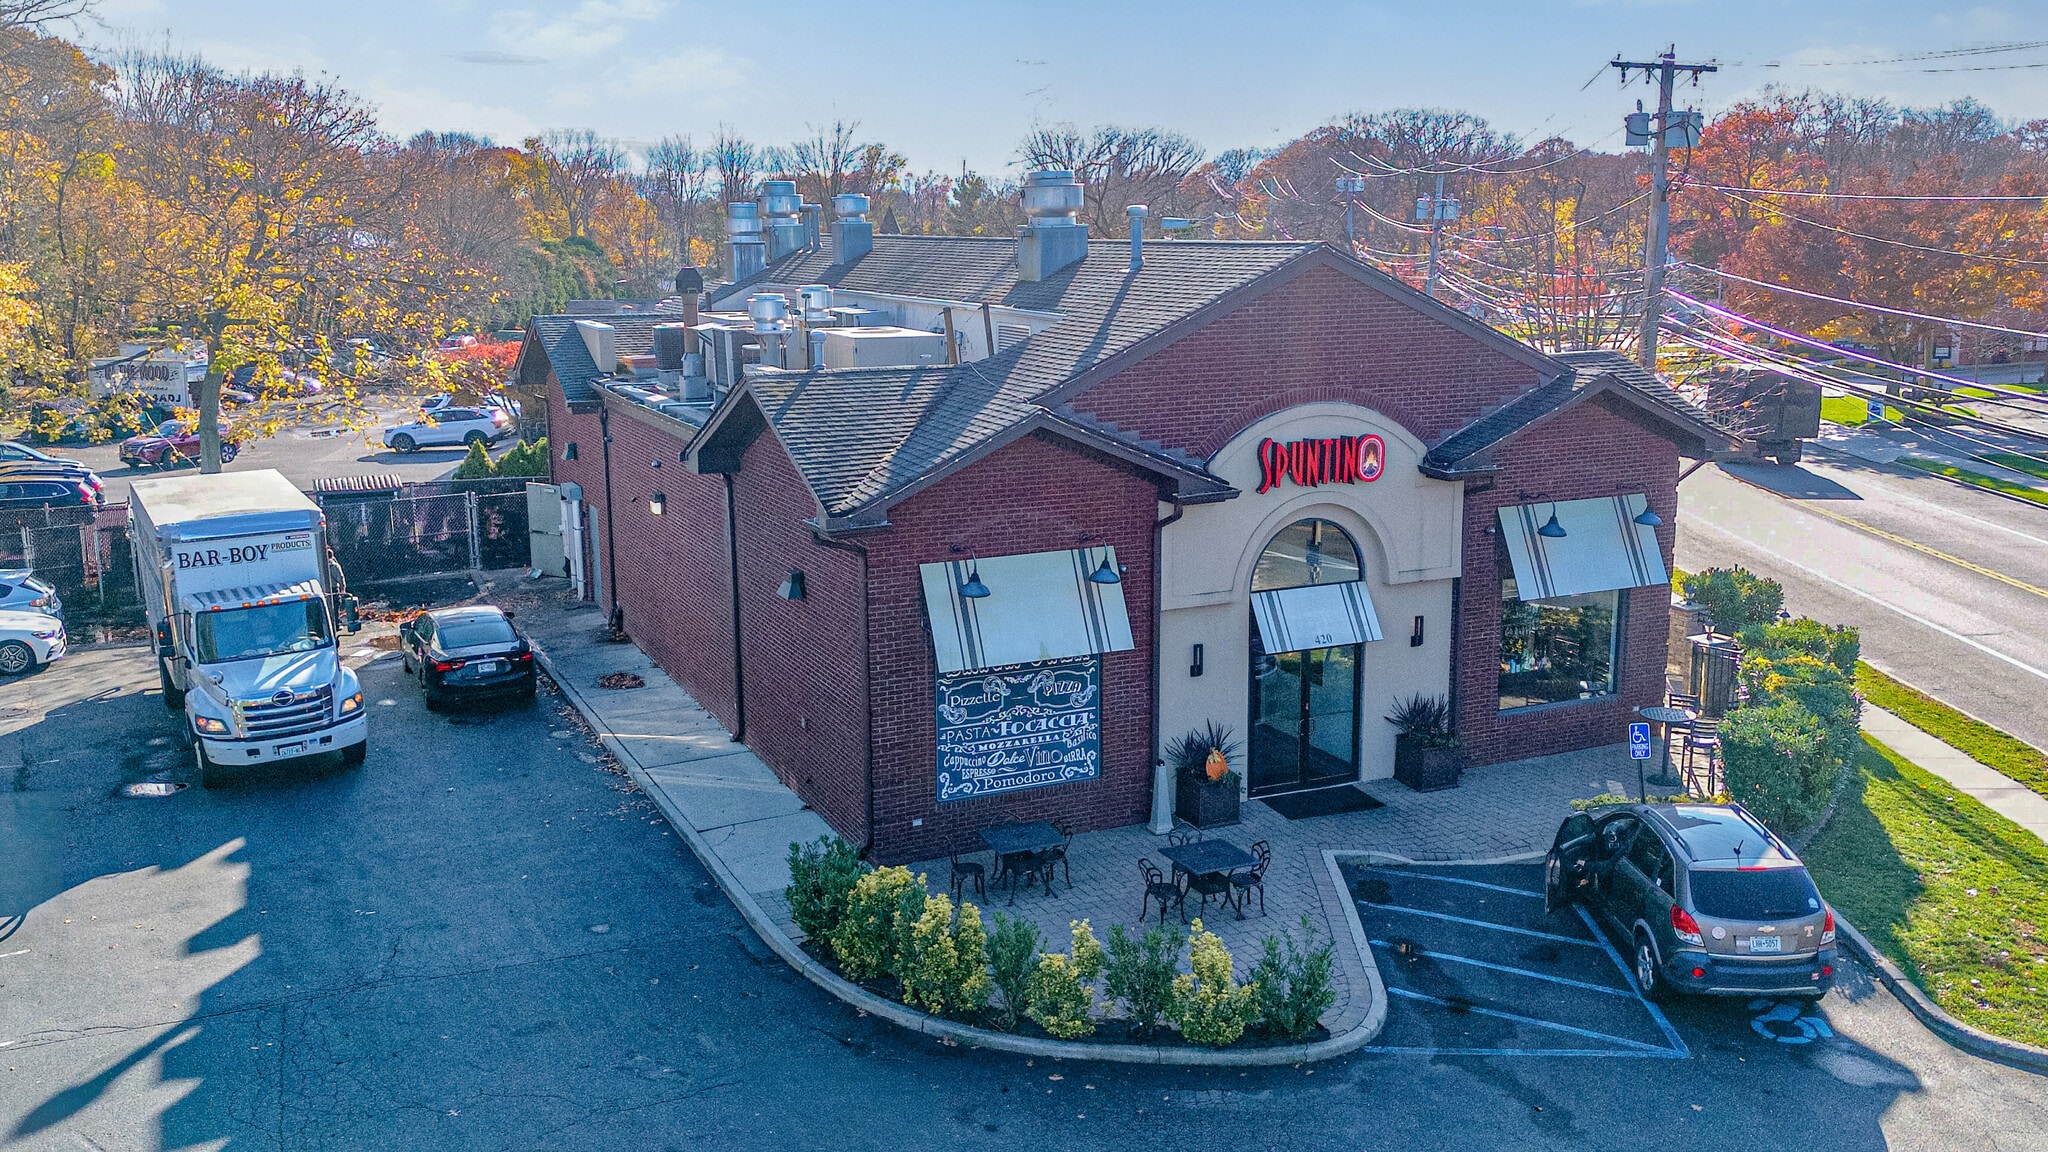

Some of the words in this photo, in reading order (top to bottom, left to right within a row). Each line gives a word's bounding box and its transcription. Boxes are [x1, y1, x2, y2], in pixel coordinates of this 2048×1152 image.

[1257, 434, 1386, 494] SPUNTINO
[177, 544, 269, 569] BAR-BOY
[271, 540, 311, 550] PRODUCTS
[1315, 633, 1333, 645] 420
[1044, 680, 1082, 696] PIZZA
[946, 726, 991, 742] PASTA
[999, 713, 1089, 736] FOCACCIA
[978, 734, 1060, 751] MOZZARELLA
[944, 753, 987, 771] Cappuccino
[987, 751, 1026, 767] Dolce
[1023, 746, 1063, 767] Vino
[1063, 747, 1087, 763] BIRRA
[962, 768, 996, 779] ESPRESSO
[984, 772, 1056, 790] Pomodoro
